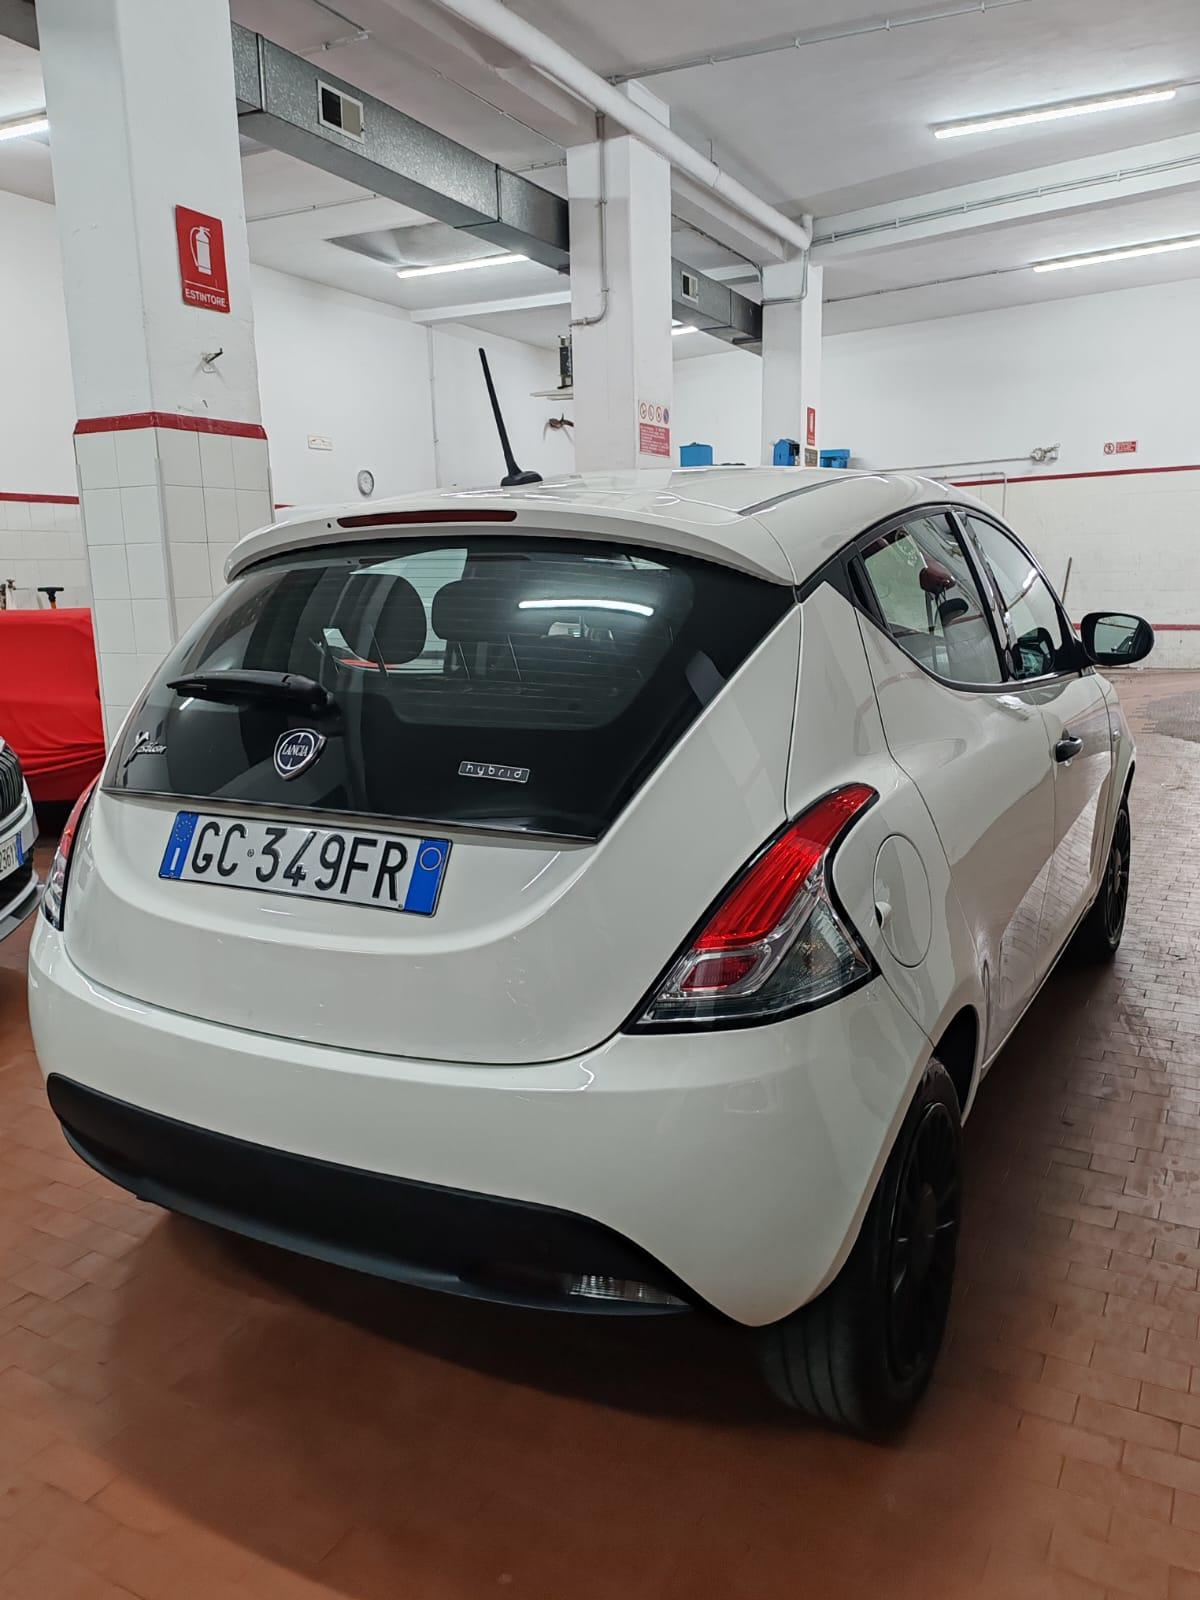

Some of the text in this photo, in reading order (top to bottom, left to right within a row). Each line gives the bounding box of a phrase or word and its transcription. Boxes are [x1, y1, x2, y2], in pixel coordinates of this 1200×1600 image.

[184, 287, 227, 307] ESTINTORE
[281, 743, 309, 757] LANCIA
[465, 763, 522, 778] hybrid
